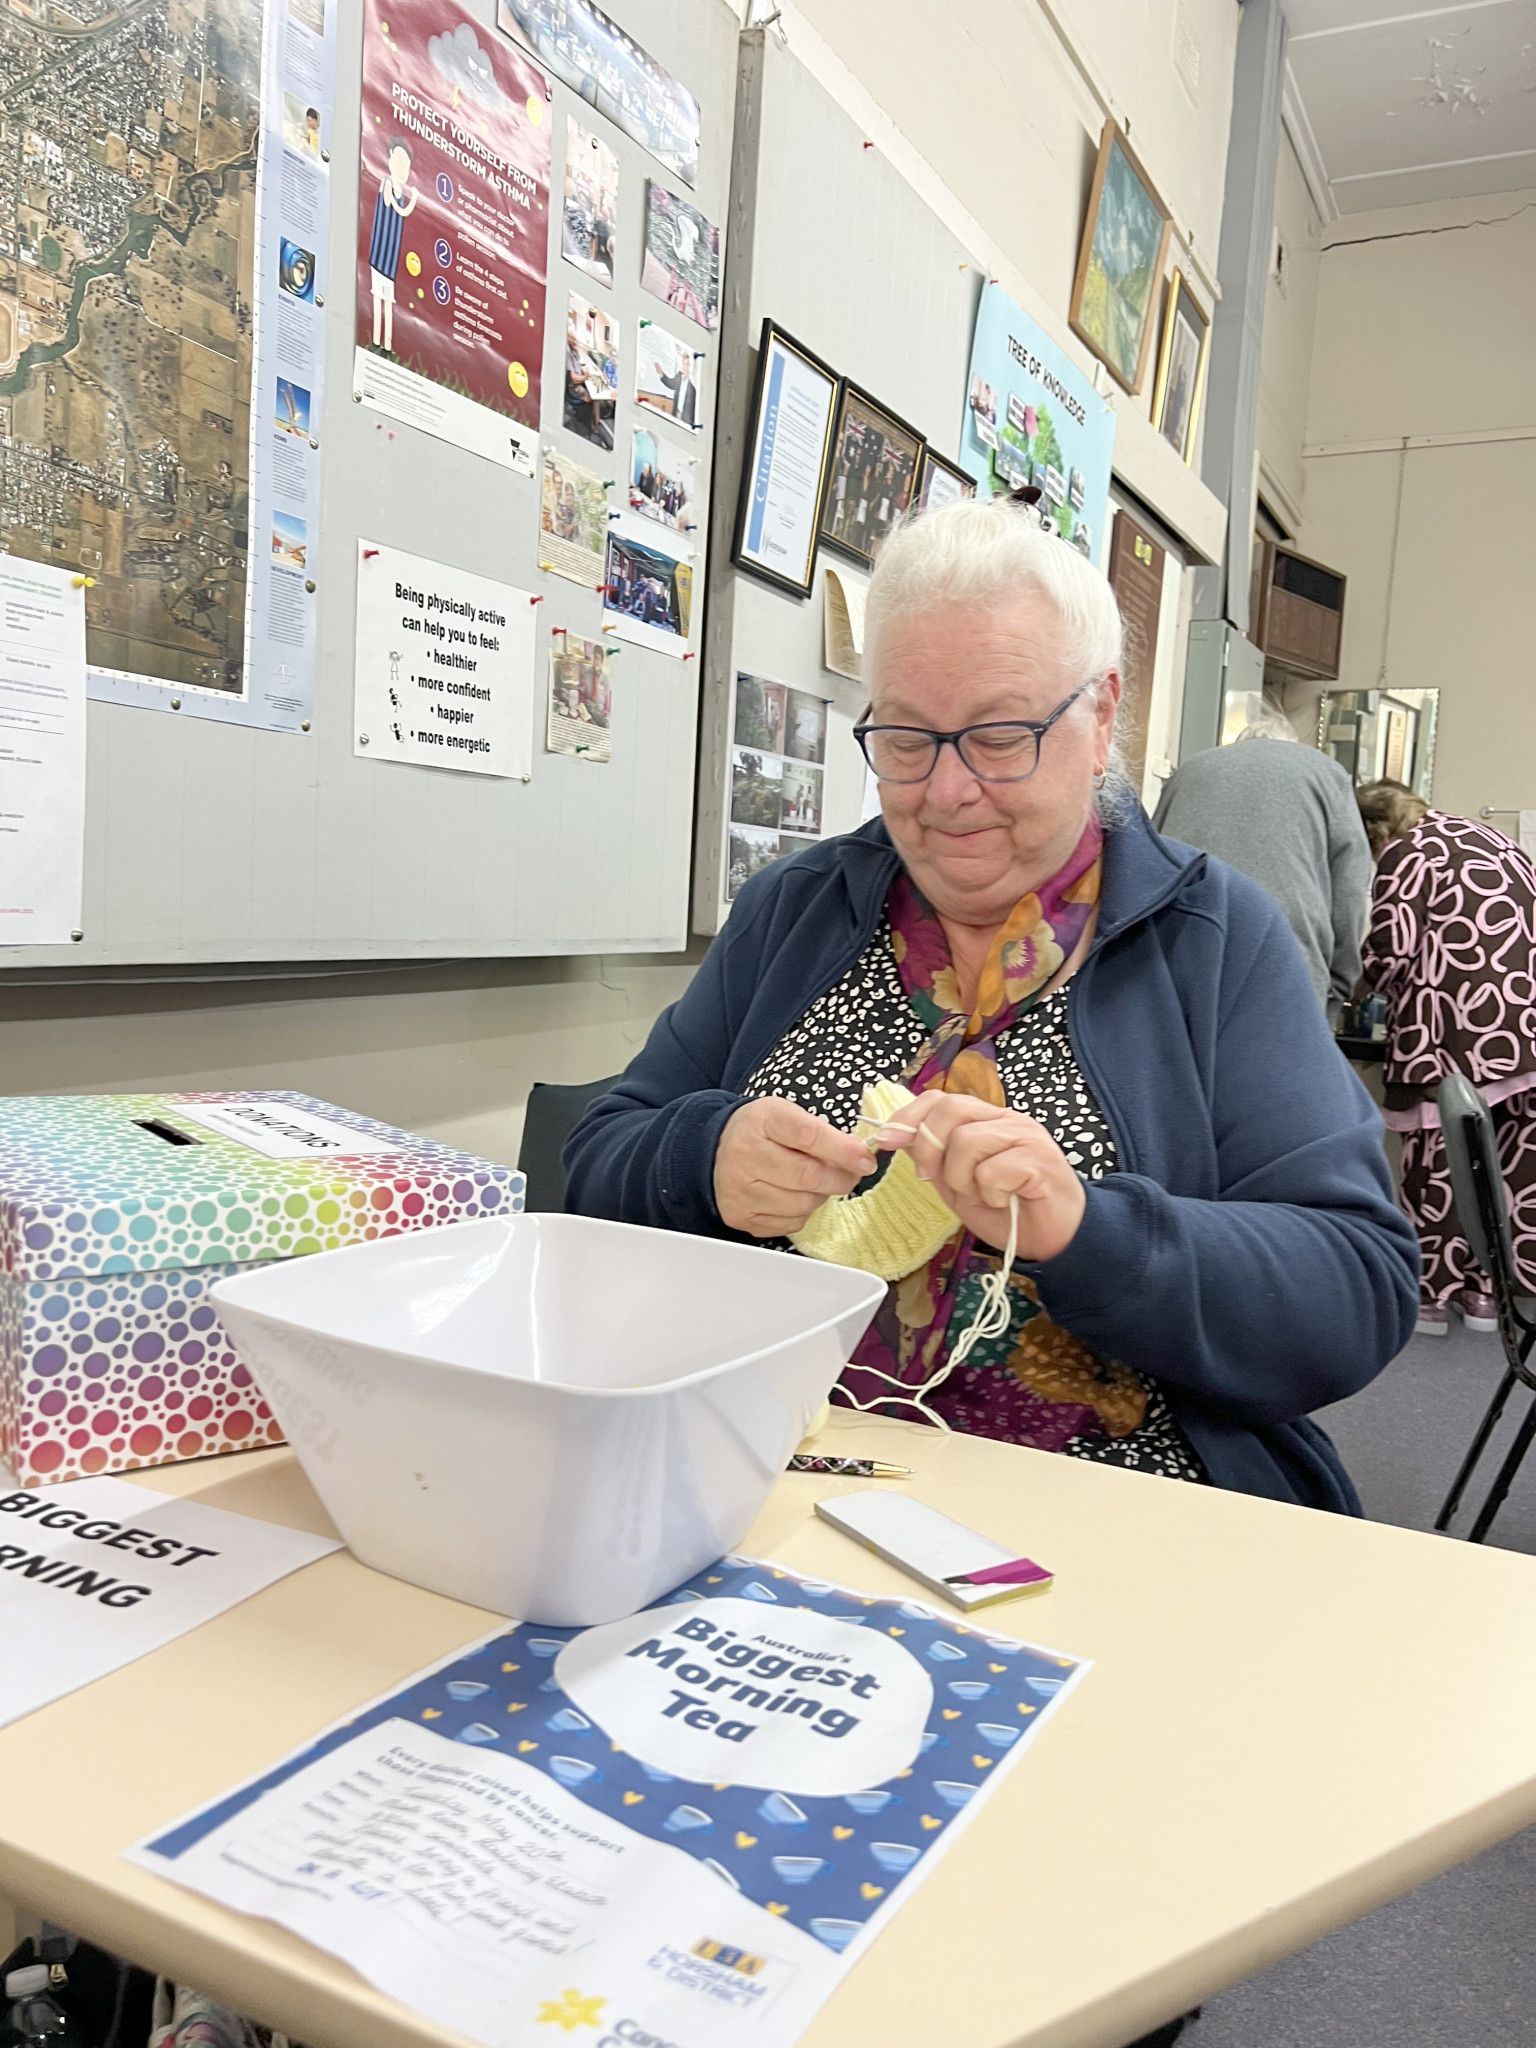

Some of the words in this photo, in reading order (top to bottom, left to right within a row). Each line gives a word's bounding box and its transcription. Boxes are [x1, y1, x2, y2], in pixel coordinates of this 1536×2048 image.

[391, 102, 486, 180] THUNDERSTORM
[487, 170, 531, 211] ASTHMA
[392, 82, 448, 130] PROTECT
[450, 122, 506, 172] YOURSELF
[507, 165, 537, 195] FROM
[441, 178, 449, 197] 1
[438, 243, 448, 263] 2
[438, 279, 447, 298] 3
[1007, 334, 1027, 369] TREE
[1028, 356, 1042, 380] OF
[1043, 366, 1086, 426] KNOWLEDGE
[755, 404, 778, 503] Citation
[395, 582, 424, 609] Being
[427, 593, 476, 623] physically
[478, 608, 506, 627] active
[402, 615, 421, 632] can
[424, 618, 446, 641] help
[448, 627, 465, 645] you
[468, 630, 478, 646] to
[480, 632, 500, 652] feel:
[433, 648, 477, 672] healthier
[418, 675, 444, 692] more
[446, 679, 491, 701] confident
[437, 704, 474, 724] happier
[418, 729, 444, 746] more
[446, 733, 491, 754] energetic
[222, 1107, 342, 1148] DONATIONS
[0, 1492, 222, 1567] BIGGEST
[673, 1616, 883, 1700] Biggest
[752, 1633, 853, 1664] Australia's
[625, 1638, 862, 1739] Morning
[659, 1689, 759, 1744] Tea
[376, 1754, 416, 1777] those
[485, 1791, 507, 1807] by
[388, 1745, 430, 1770] Every
[472, 1773, 523, 1798] raised
[520, 1793, 562, 1826] helps
[560, 1822, 626, 1855] support
